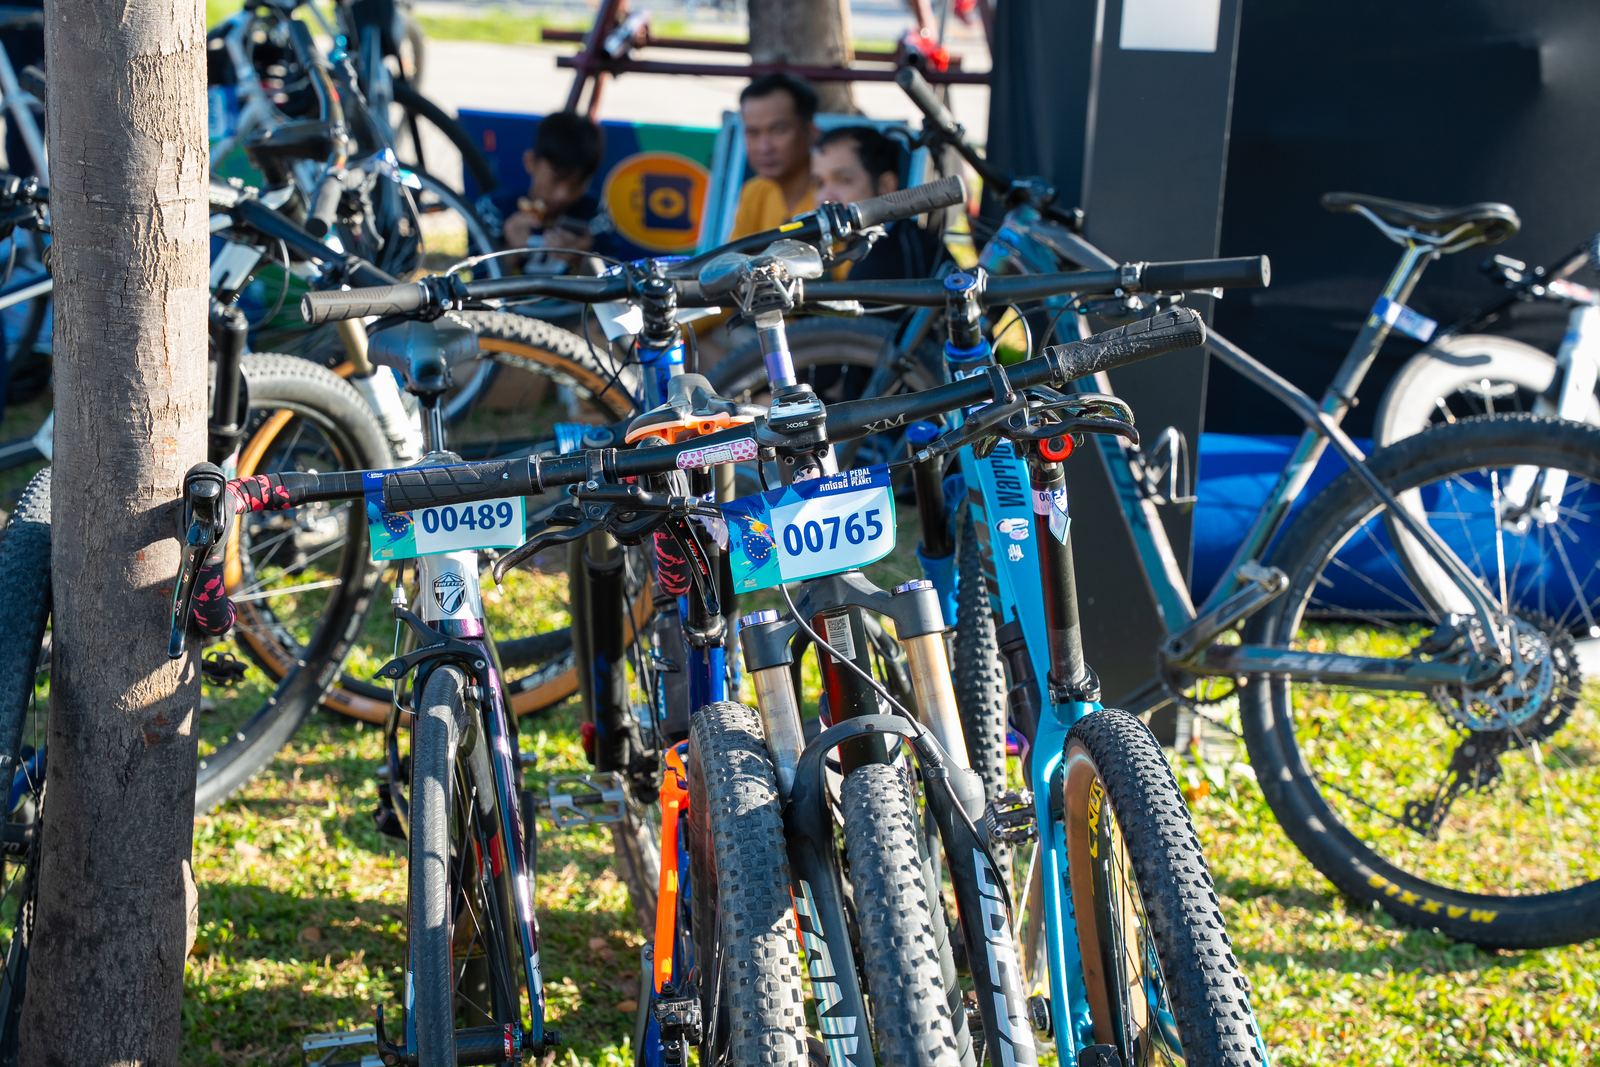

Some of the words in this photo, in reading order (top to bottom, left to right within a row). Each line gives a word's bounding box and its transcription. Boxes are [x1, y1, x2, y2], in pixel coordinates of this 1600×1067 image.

[786, 420, 809, 429] XOSS
[849, 467, 871, 478] PEDAL
[851, 477, 872, 487] PLANET
[421, 501, 514, 534] 00489
[782, 508, 883, 557] 00765
